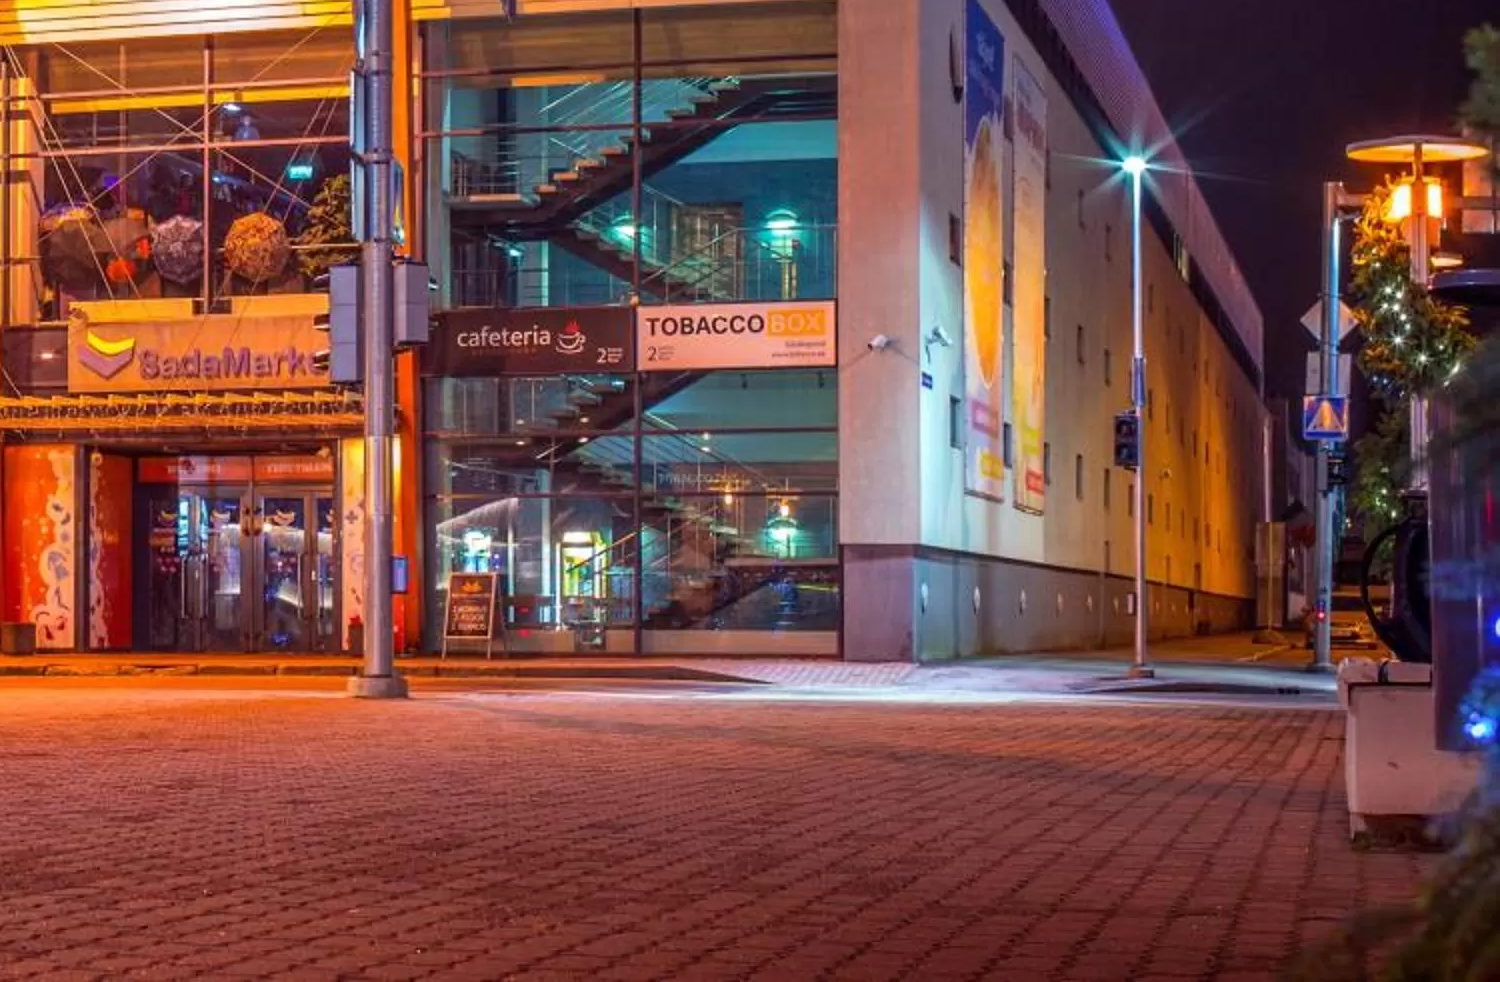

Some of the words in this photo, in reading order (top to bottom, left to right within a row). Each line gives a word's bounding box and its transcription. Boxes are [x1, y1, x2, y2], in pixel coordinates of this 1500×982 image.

[456, 323, 552, 348] cafeteria
[645, 314, 765, 336] TOBACCO
[771, 312, 822, 334] BOX
[139, 346, 329, 380] SadaMarke
[596, 347, 607, 364] 2
[647, 345, 658, 362] 2
